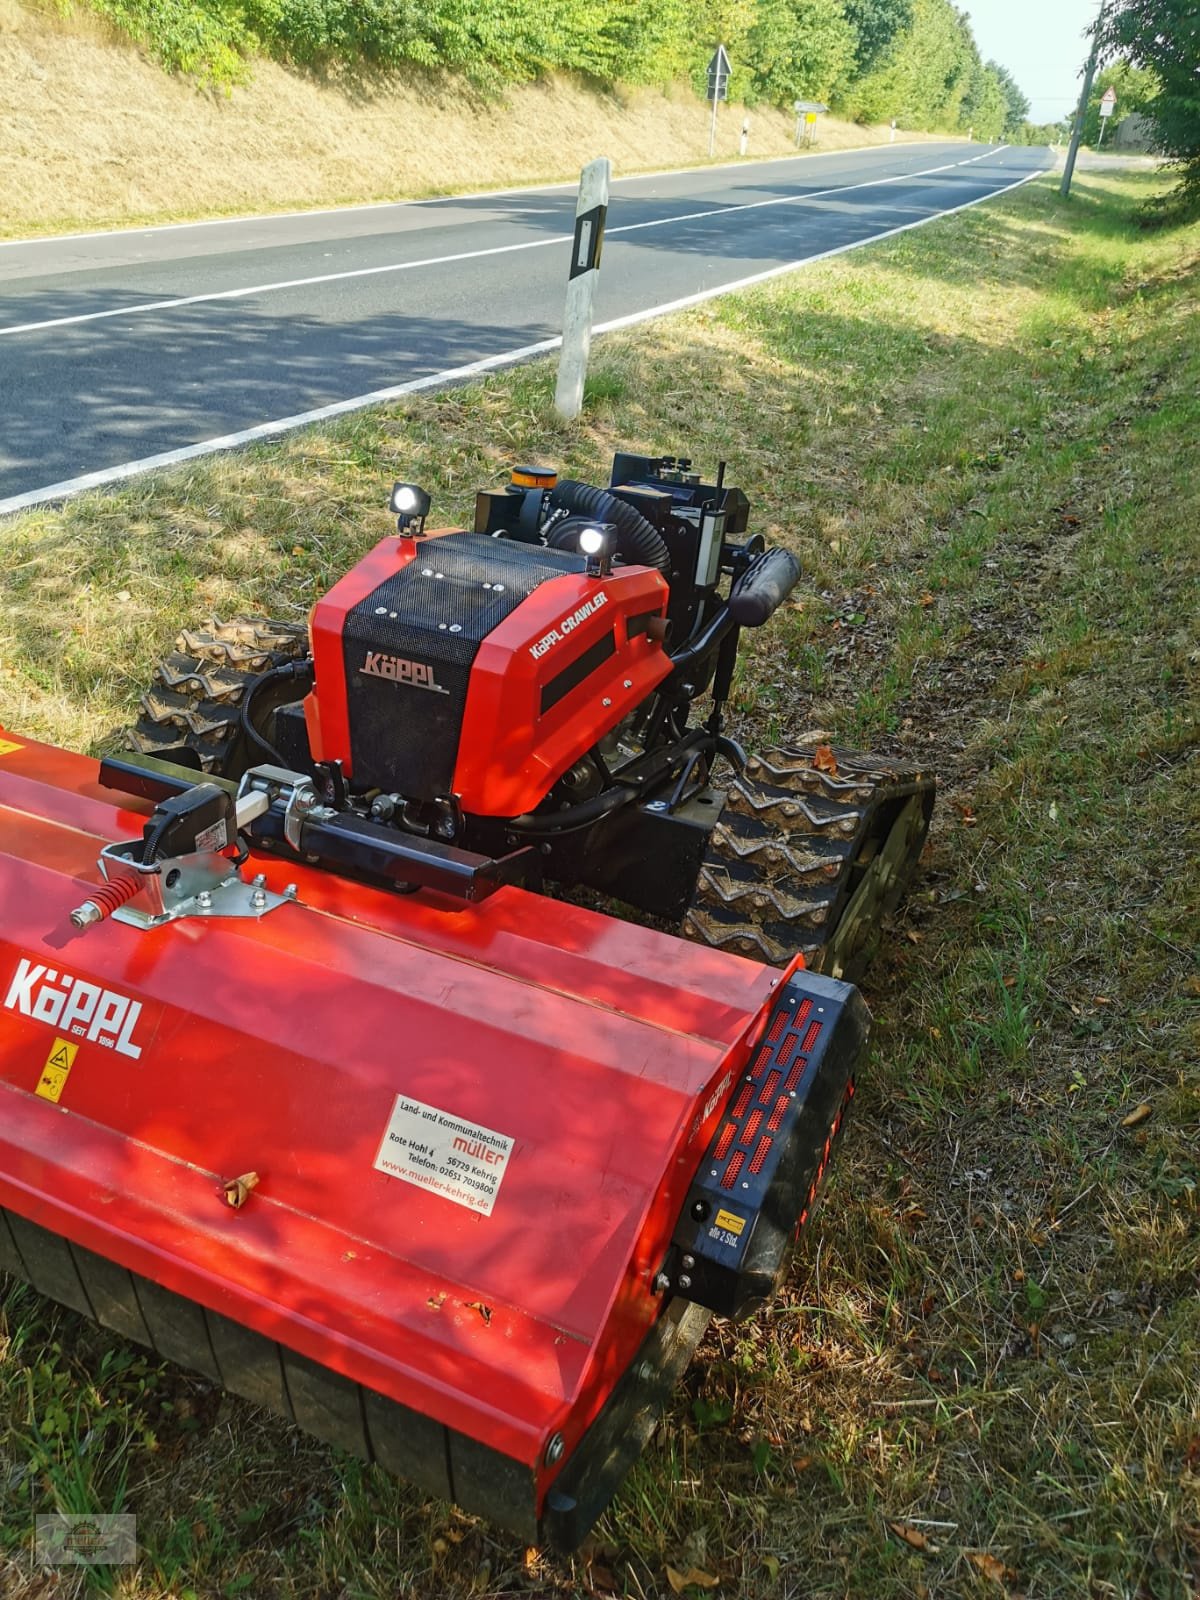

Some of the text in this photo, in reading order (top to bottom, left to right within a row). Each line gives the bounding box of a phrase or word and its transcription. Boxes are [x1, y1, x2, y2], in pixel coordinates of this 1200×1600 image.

[561, 591, 608, 634] CRAWLER
[400, 1101, 509, 1151] Land- und Kommunaltechnik
[389, 1132, 498, 1185] Rote Hohl 4 56729 Kehrig
[408, 1152, 495, 1195] Telefon: 02651 7019800
[382, 1159, 490, 1209] www.mueller-kehrig.de
[708, 1226, 721, 1240] alle
[719, 1231, 726, 1242] 2
